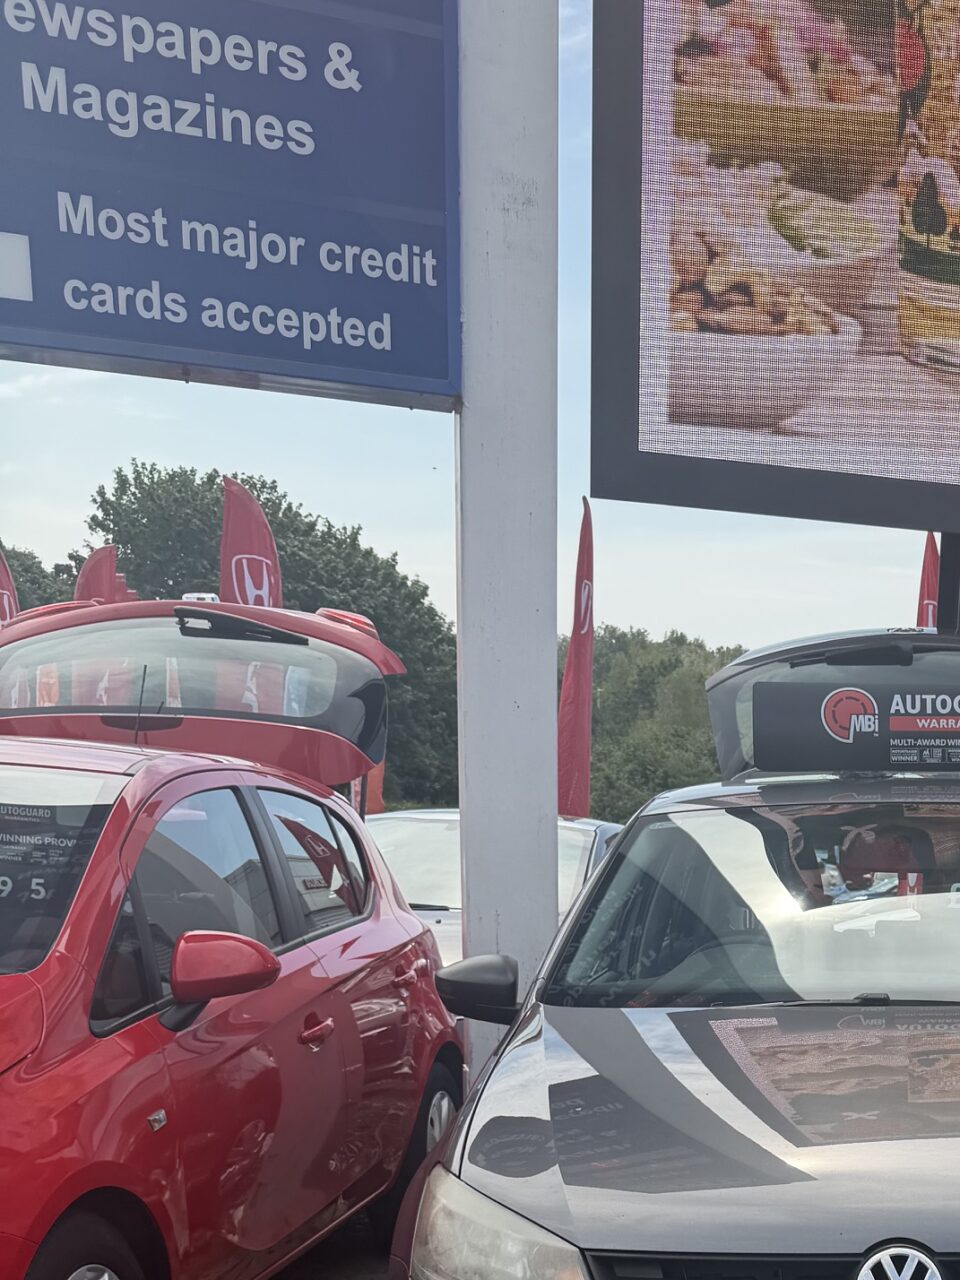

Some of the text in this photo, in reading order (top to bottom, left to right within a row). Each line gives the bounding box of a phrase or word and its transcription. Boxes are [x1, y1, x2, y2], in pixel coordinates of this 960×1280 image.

[4, 0, 362, 92] ewspapers &
[20, 61, 316, 155] Magazines
[57, 191, 437, 287] Most major credit
[64, 279, 391, 349] cards accepted
[890, 738, 946, 746] MULTI-AWARD
